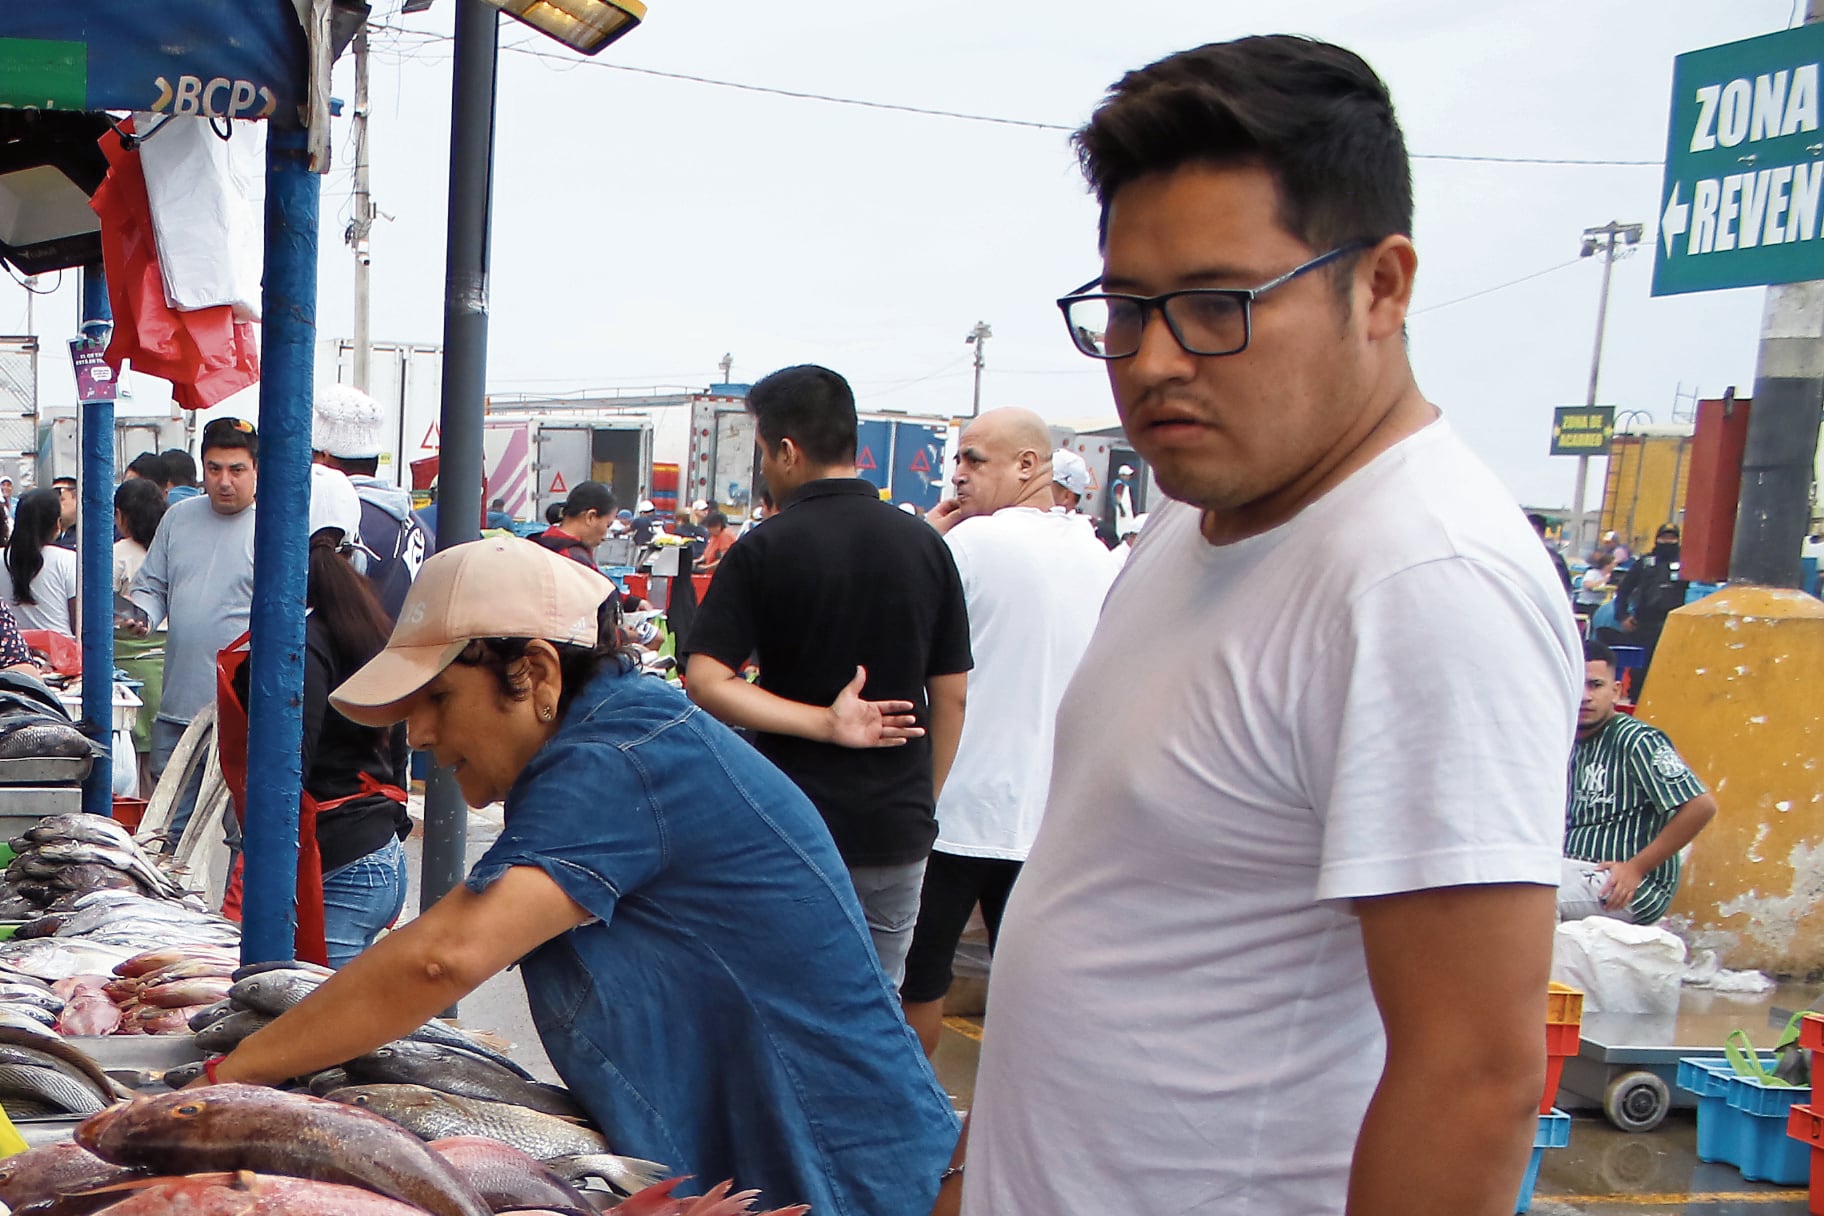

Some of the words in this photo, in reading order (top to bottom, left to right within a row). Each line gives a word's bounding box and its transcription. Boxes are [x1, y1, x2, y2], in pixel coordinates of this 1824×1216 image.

[176, 75, 256, 117] BCP
[1689, 63, 1819, 153] ZONA
[1687, 161, 1824, 255] REVEN
